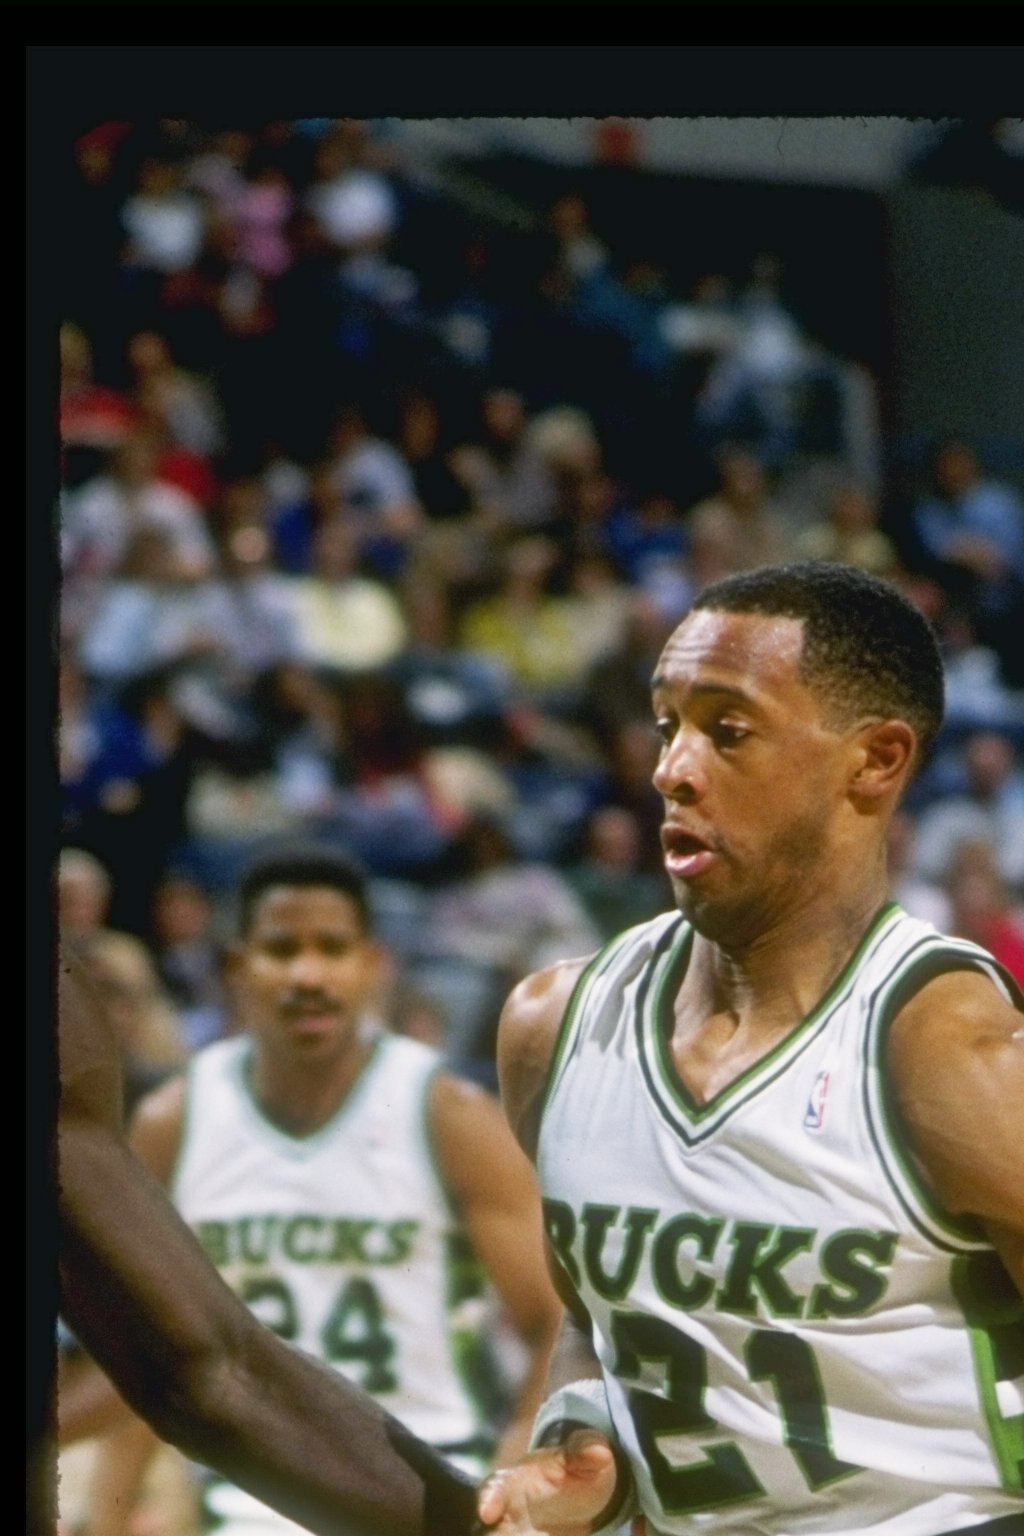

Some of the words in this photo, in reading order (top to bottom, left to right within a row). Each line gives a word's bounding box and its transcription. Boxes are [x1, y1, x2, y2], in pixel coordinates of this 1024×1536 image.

[197, 1214, 421, 1266] BUCKS
[542, 1198, 901, 1321] BUCKS
[610, 1309, 868, 1516] 21
